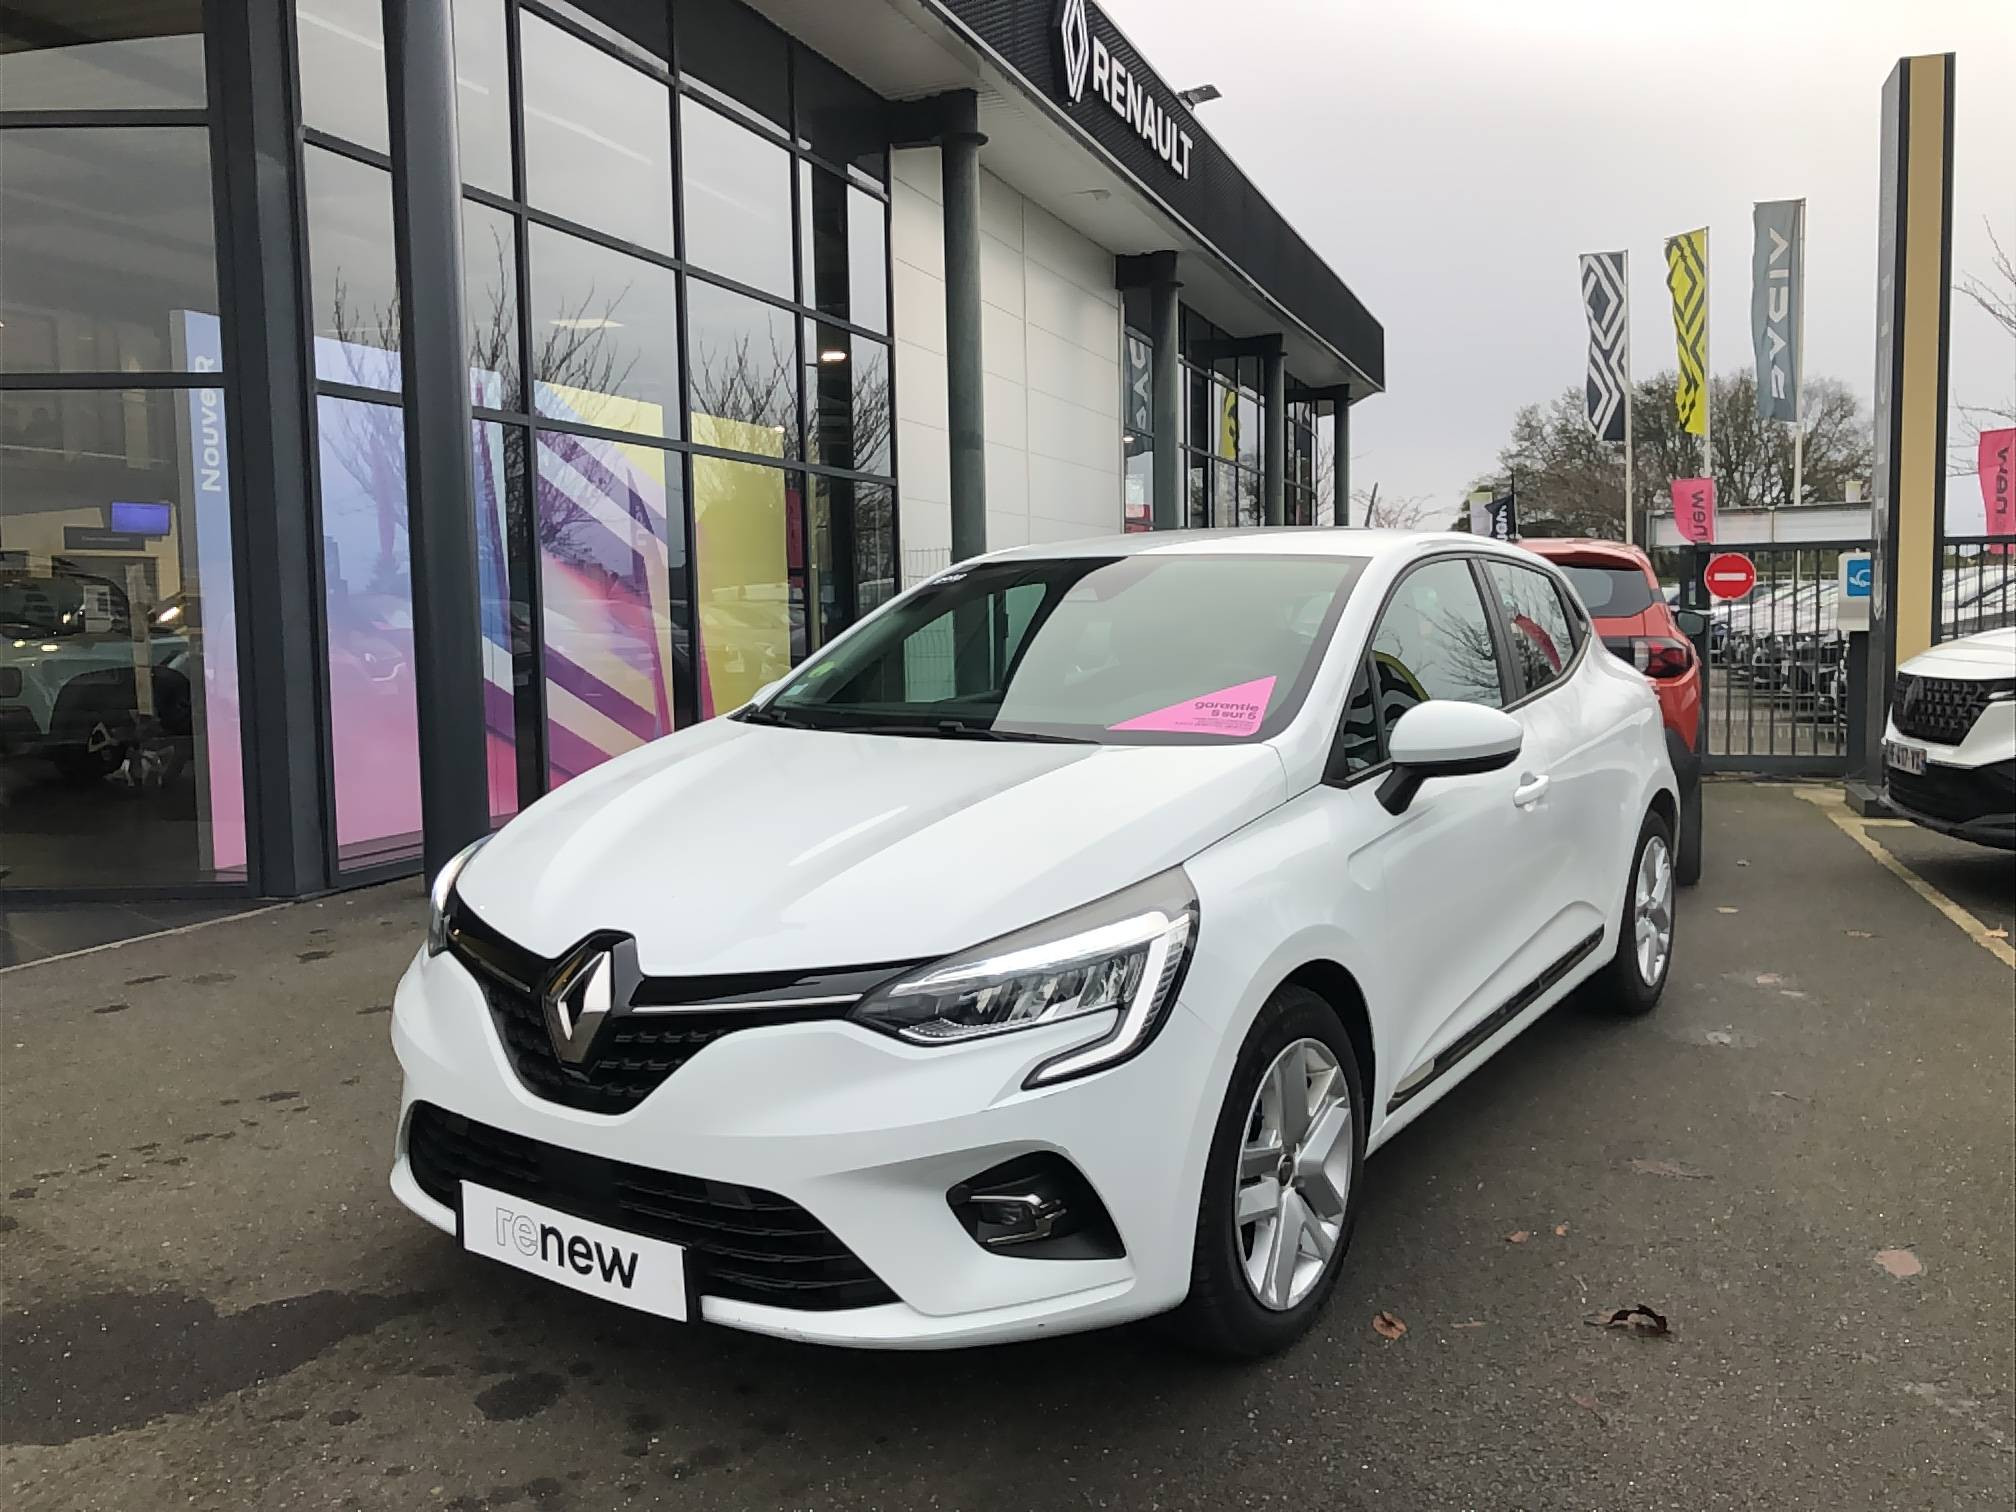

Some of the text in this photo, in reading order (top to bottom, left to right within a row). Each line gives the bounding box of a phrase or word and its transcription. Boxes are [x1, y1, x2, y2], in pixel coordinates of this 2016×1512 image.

[1093, 35, 1193, 180] RENAULT
[1194, 701, 1260, 713] garantie
[1222, 711, 1245, 719] sur
[495, 1206, 639, 1289] renew
